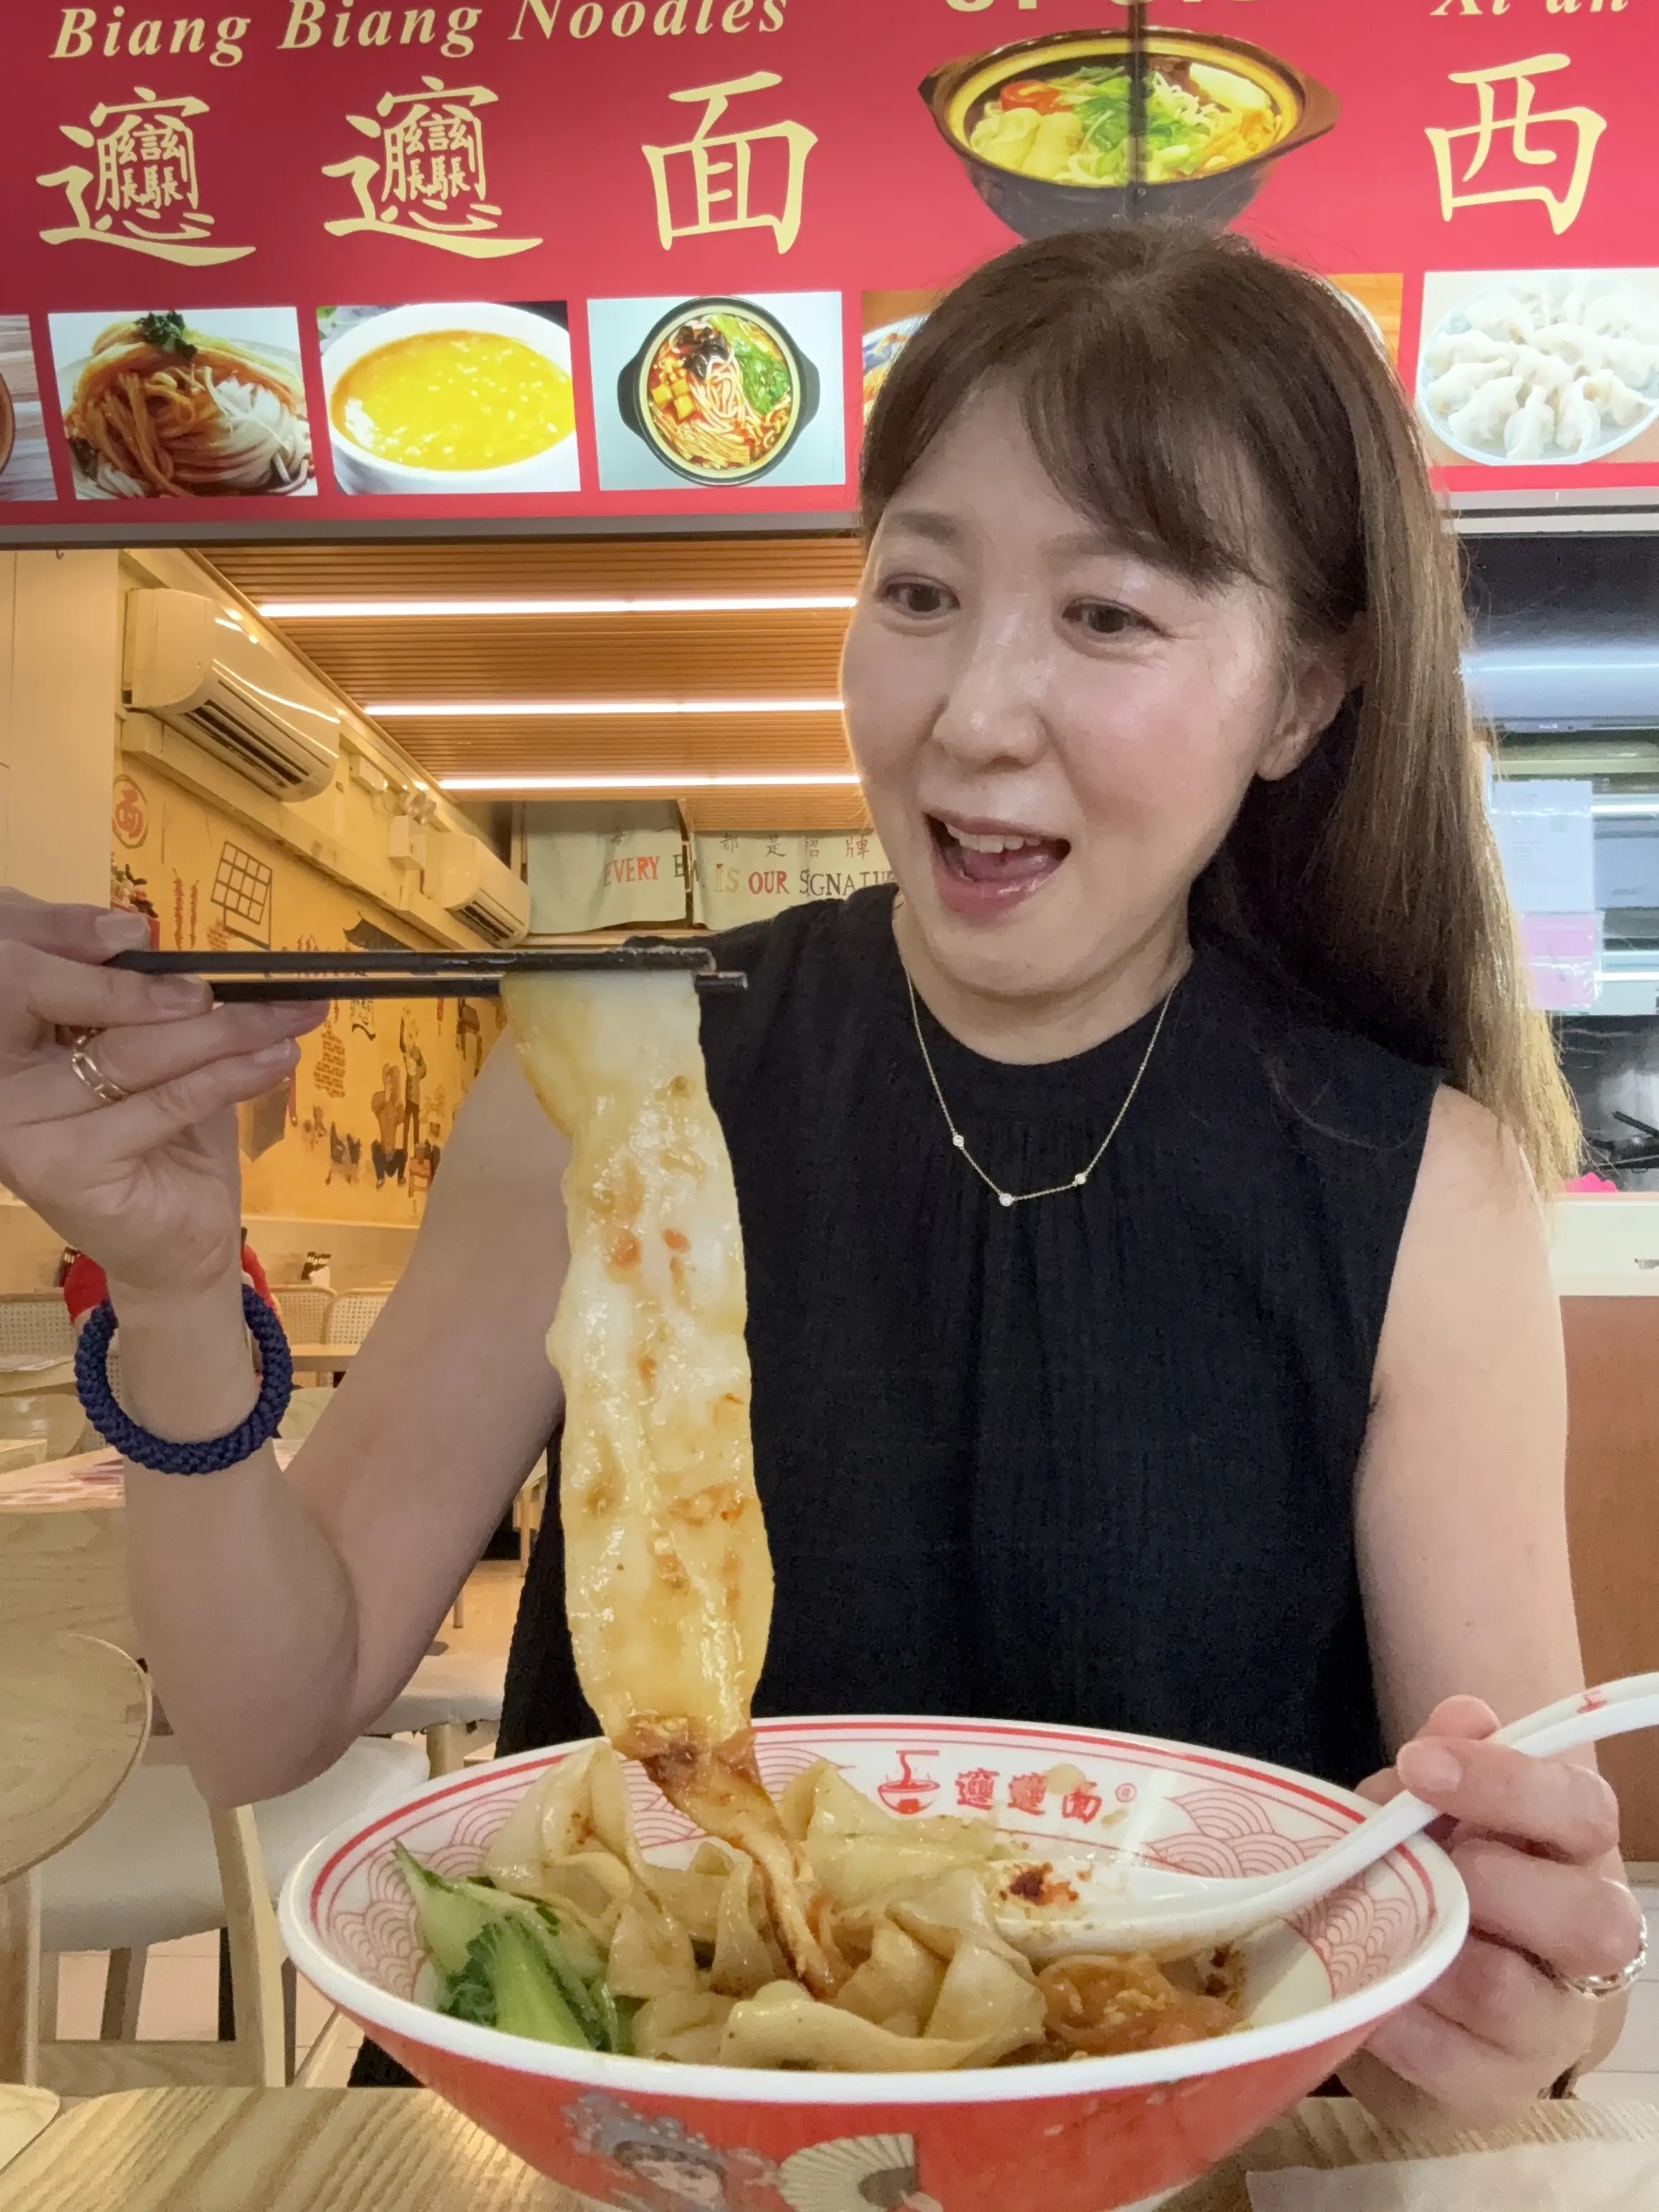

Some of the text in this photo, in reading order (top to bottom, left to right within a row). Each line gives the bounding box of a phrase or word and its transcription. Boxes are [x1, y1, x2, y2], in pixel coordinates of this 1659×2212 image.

[51, 0, 787, 67] Biang Biang Noodles
[1423, 52, 1608, 236] 西
[604, 855, 660, 887] EVERY
[748, 870, 791, 895] OUR
